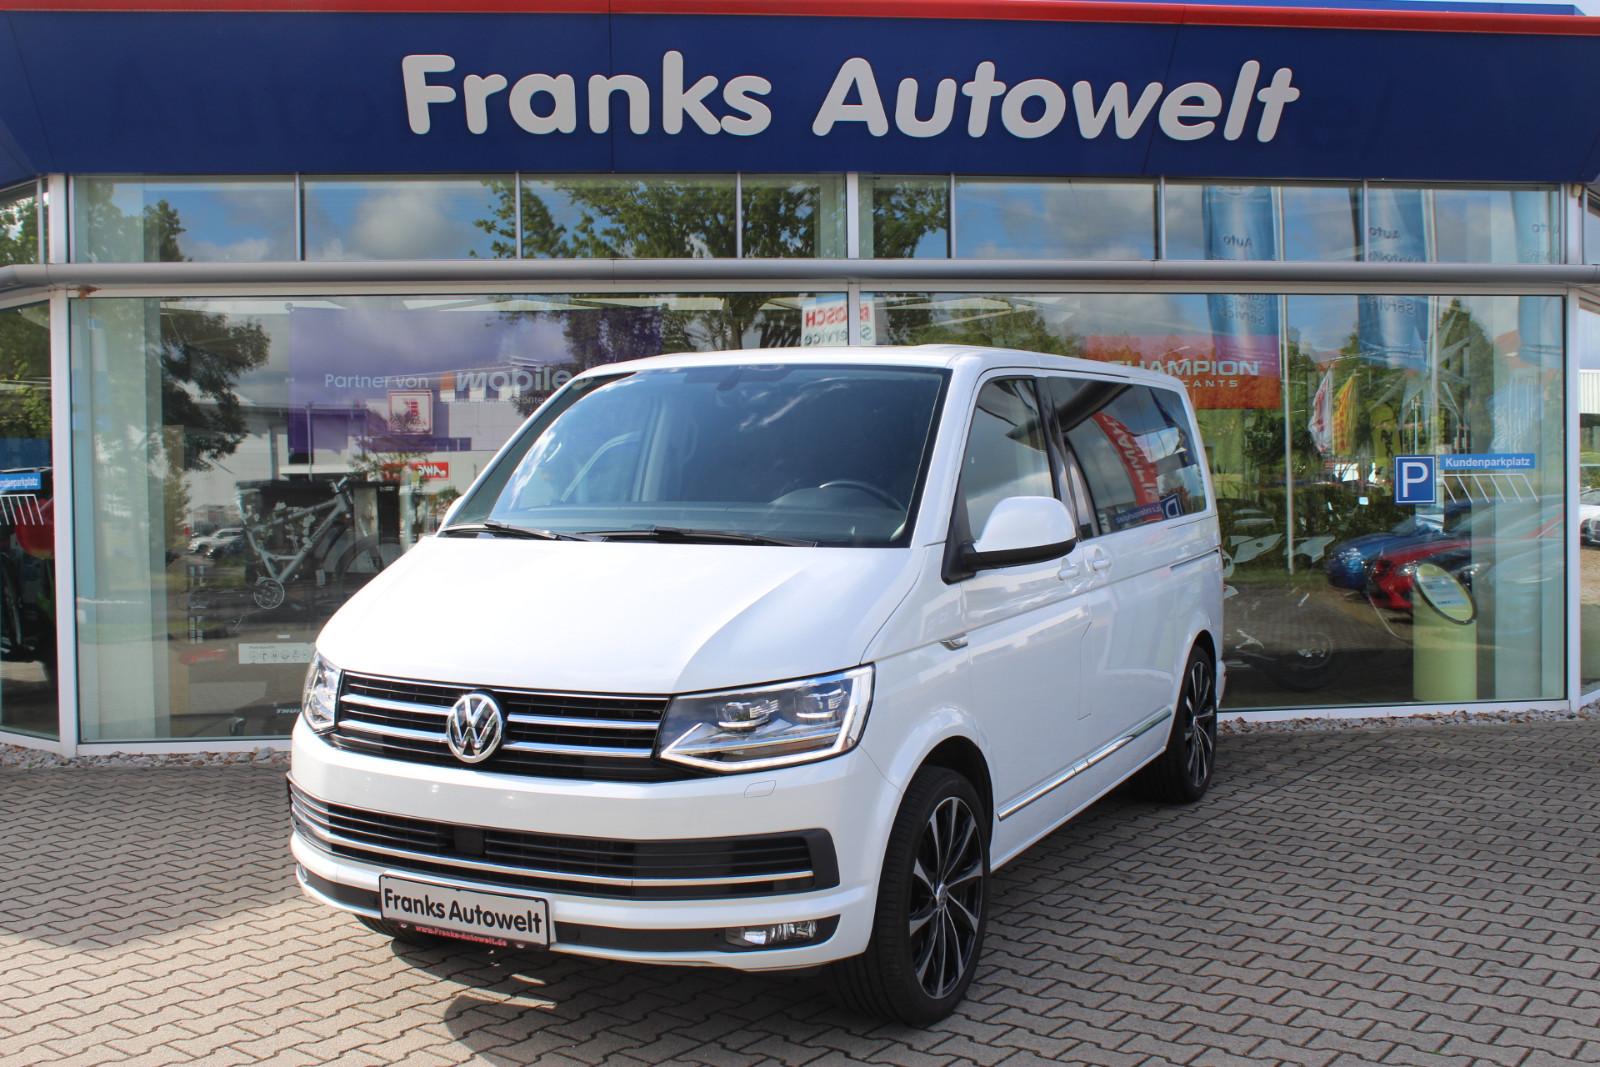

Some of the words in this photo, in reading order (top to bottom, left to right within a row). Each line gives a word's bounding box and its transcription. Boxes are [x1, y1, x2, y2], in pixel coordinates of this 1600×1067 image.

[401, 50, 772, 136] Franks
[811, 57, 1300, 143] Autowelt
[324, 373, 389, 388] Partner
[395, 375, 429, 388] von
[1108, 359, 1260, 377] AMPION
[1445, 456, 1531, 468] Kundenparkplatz
[1402, 462, 1429, 498] P
[384, 888, 446, 918] Franks
[449, 900, 542, 933] Autowelt
